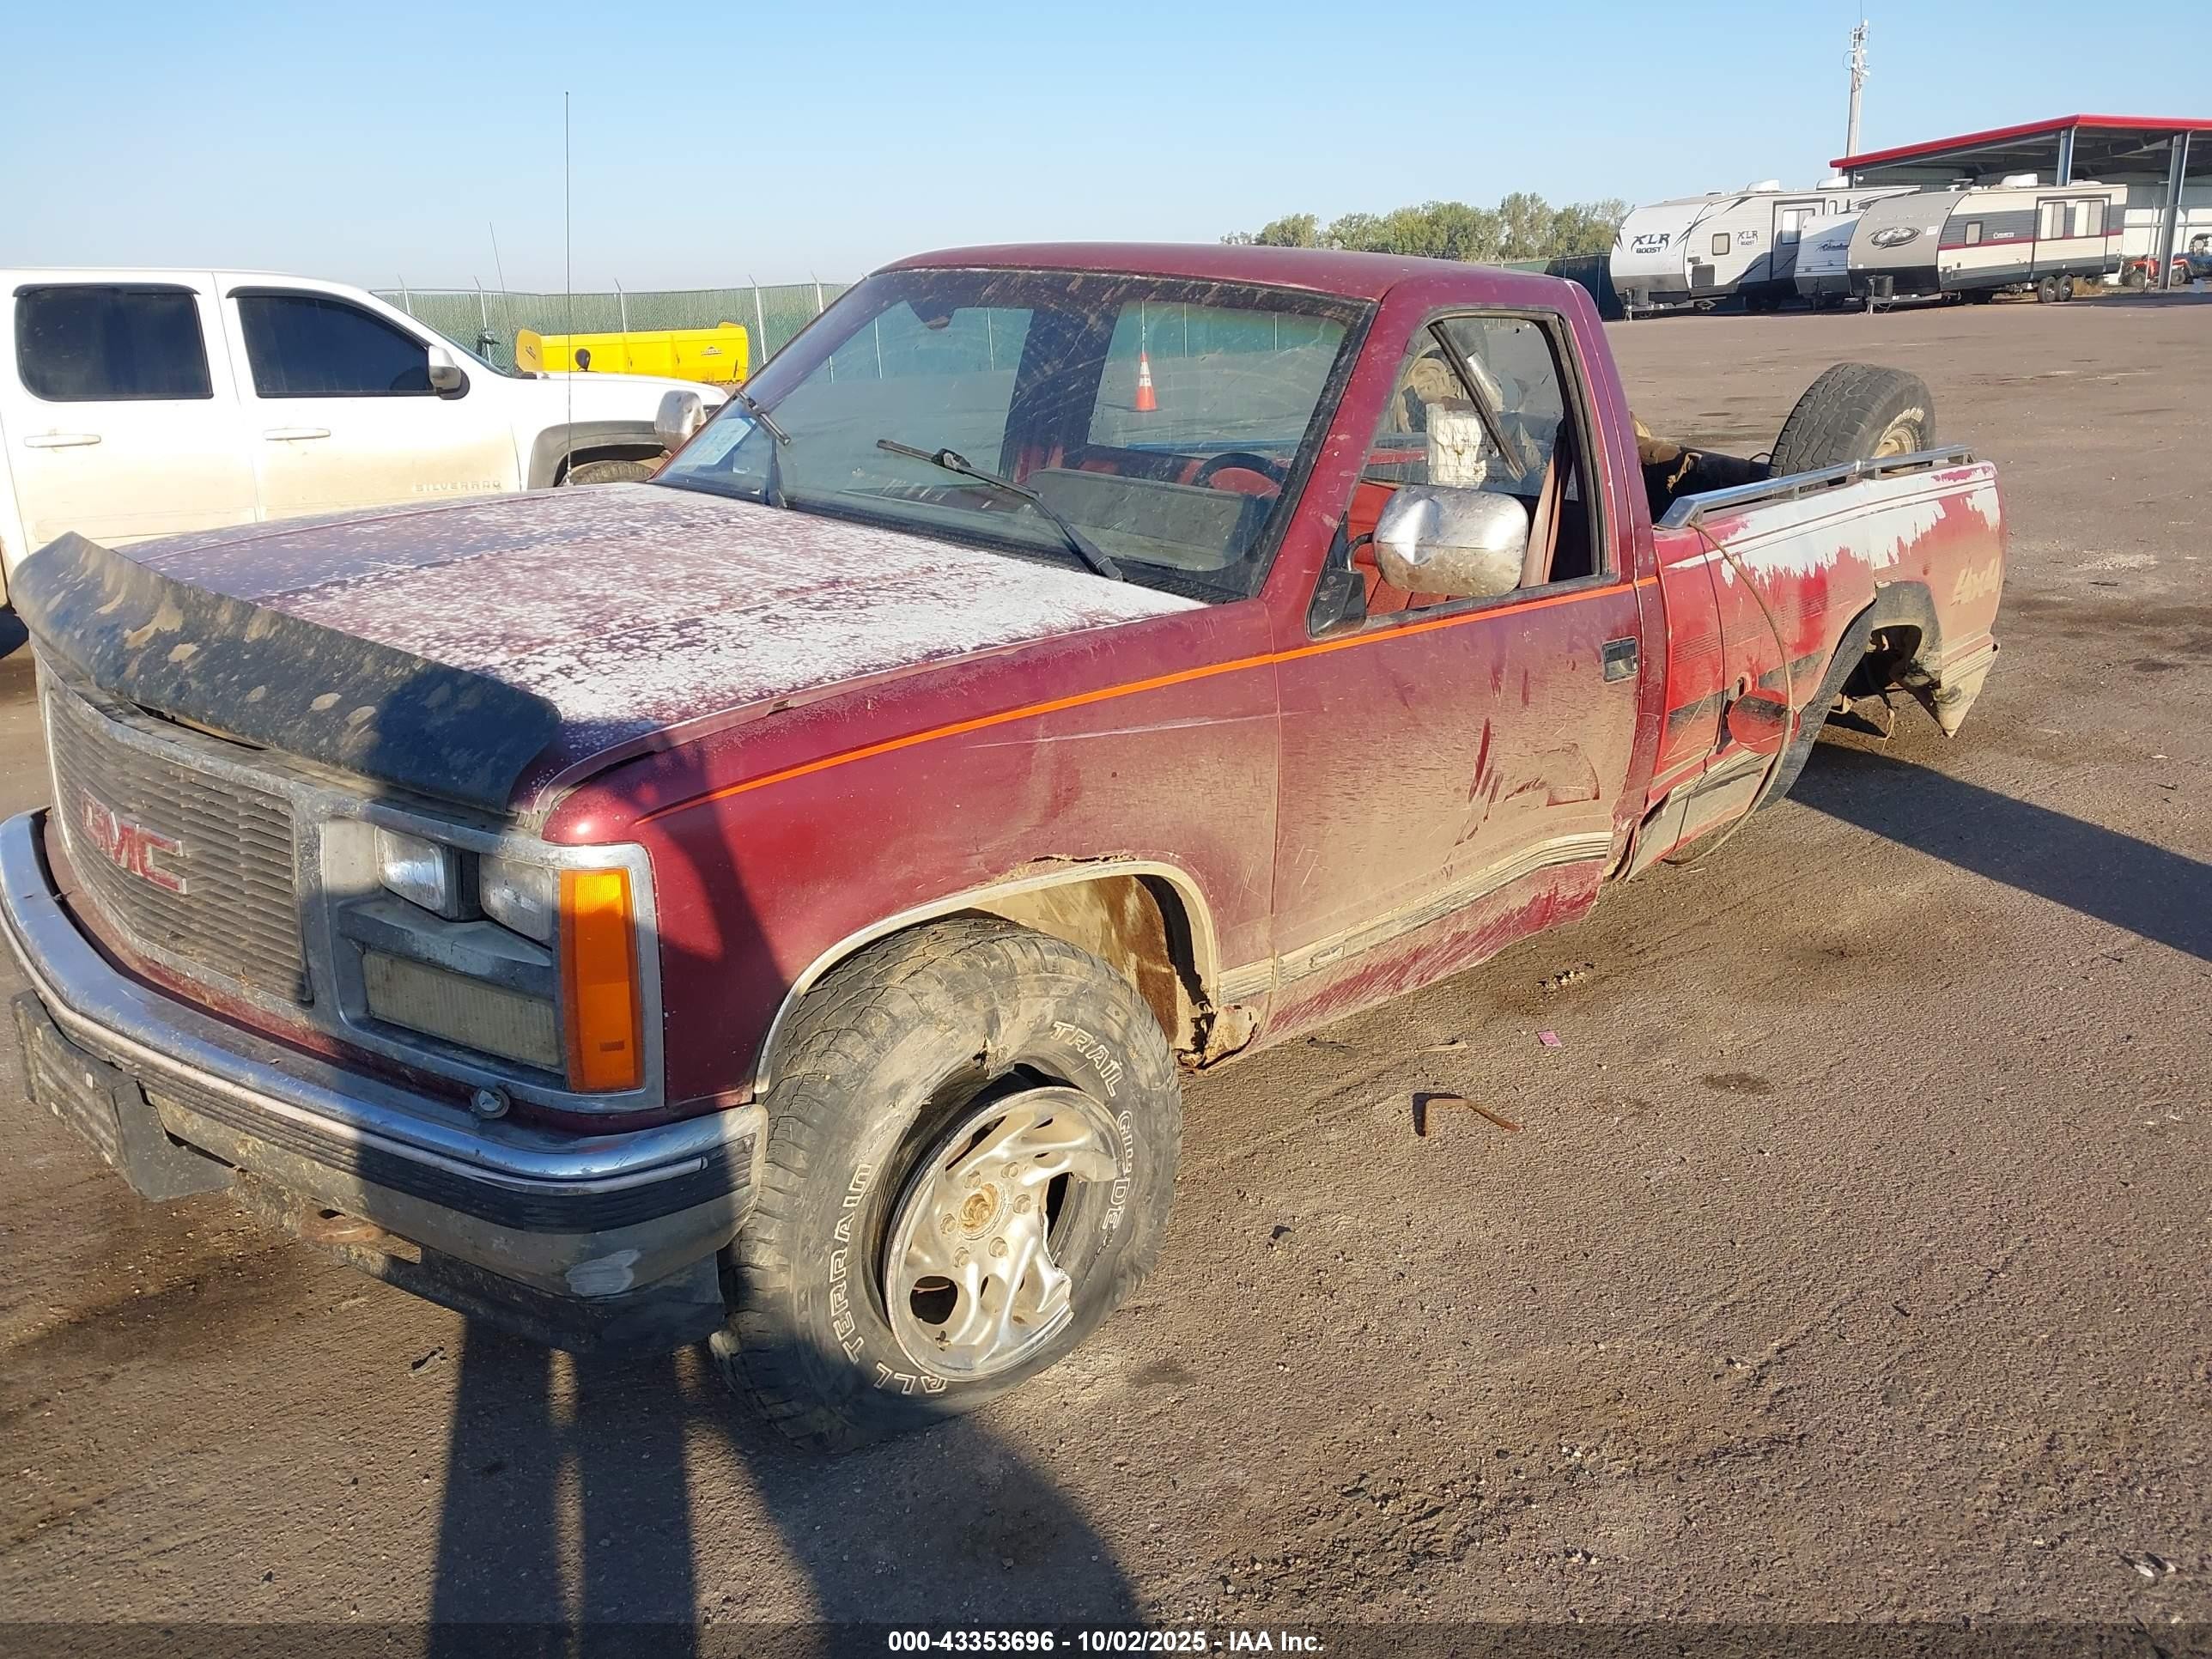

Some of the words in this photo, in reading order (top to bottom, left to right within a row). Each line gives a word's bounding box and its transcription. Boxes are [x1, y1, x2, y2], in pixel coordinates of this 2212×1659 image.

[1631, 234, 1671, 251] XLR
[1737, 230, 1758, 244] XLR
[82, 787, 187, 895] GMC
[1051, 1021, 1123, 1097] TRAIL
[830, 1163, 872, 1364] TERRAIN
[873, 1361, 947, 1395] ALL
